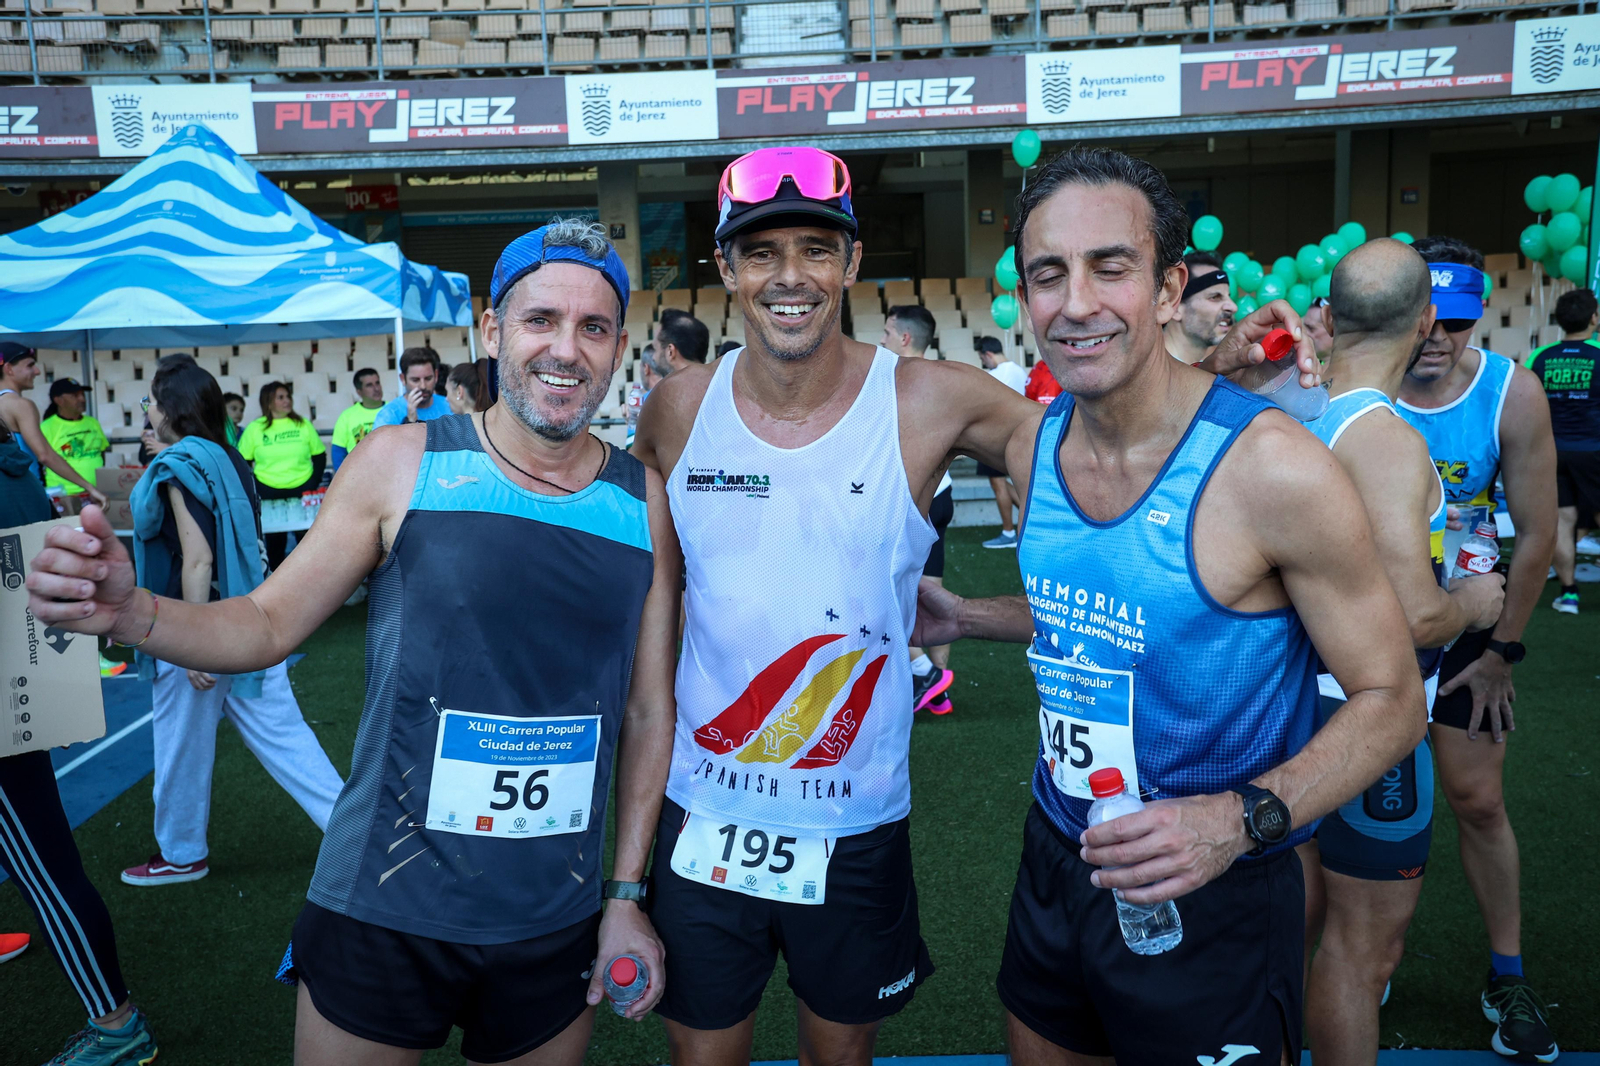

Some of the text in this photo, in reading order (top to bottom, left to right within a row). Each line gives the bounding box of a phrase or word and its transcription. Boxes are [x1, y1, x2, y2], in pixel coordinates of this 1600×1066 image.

[1573, 54, 1588, 66] de
[1201, 43, 1457, 100] PLAY JEREZ
[1079, 73, 1165, 87] Ayuntamiento
[736, 72, 975, 126] PLAY JEREZ
[1079, 87, 1127, 99] de Jerez
[619, 98, 702, 112] Ayuntamiento
[152, 110, 239, 124] Ayuntamiento
[275, 89, 516, 143] PLAY JEREZ
[619, 110, 666, 122] de Jerez
[153, 123, 167, 133] de
[1544, 369, 1593, 383] PORTO
[686, 485, 769, 493] WORLD CHAMPIONSHIP
[1026, 573, 1146, 626] MEMORIAL
[1036, 608, 1066, 629] MARINA
[1069, 621, 1115, 645] CARMONA
[1117, 637, 1145, 654] PAEZ
[1072, 607, 1086, 621] DE
[1089, 611, 1144, 640] INFANTERIA
[1039, 665, 1075, 683] Carrera
[1075, 673, 1113, 689] Popular
[1059, 688, 1072, 700] de
[1073, 691, 1096, 706] Jerez
[468, 721, 586, 736] XLIII Carrera Popular
[478, 738, 573, 751] Ciudad de Jerez
[507, 754, 537, 762] Noviembre
[489, 769, 550, 811] 56
[801, 779, 851, 800] TEAM
[718, 823, 797, 875] 195
[878, 966, 915, 999] HOKA
